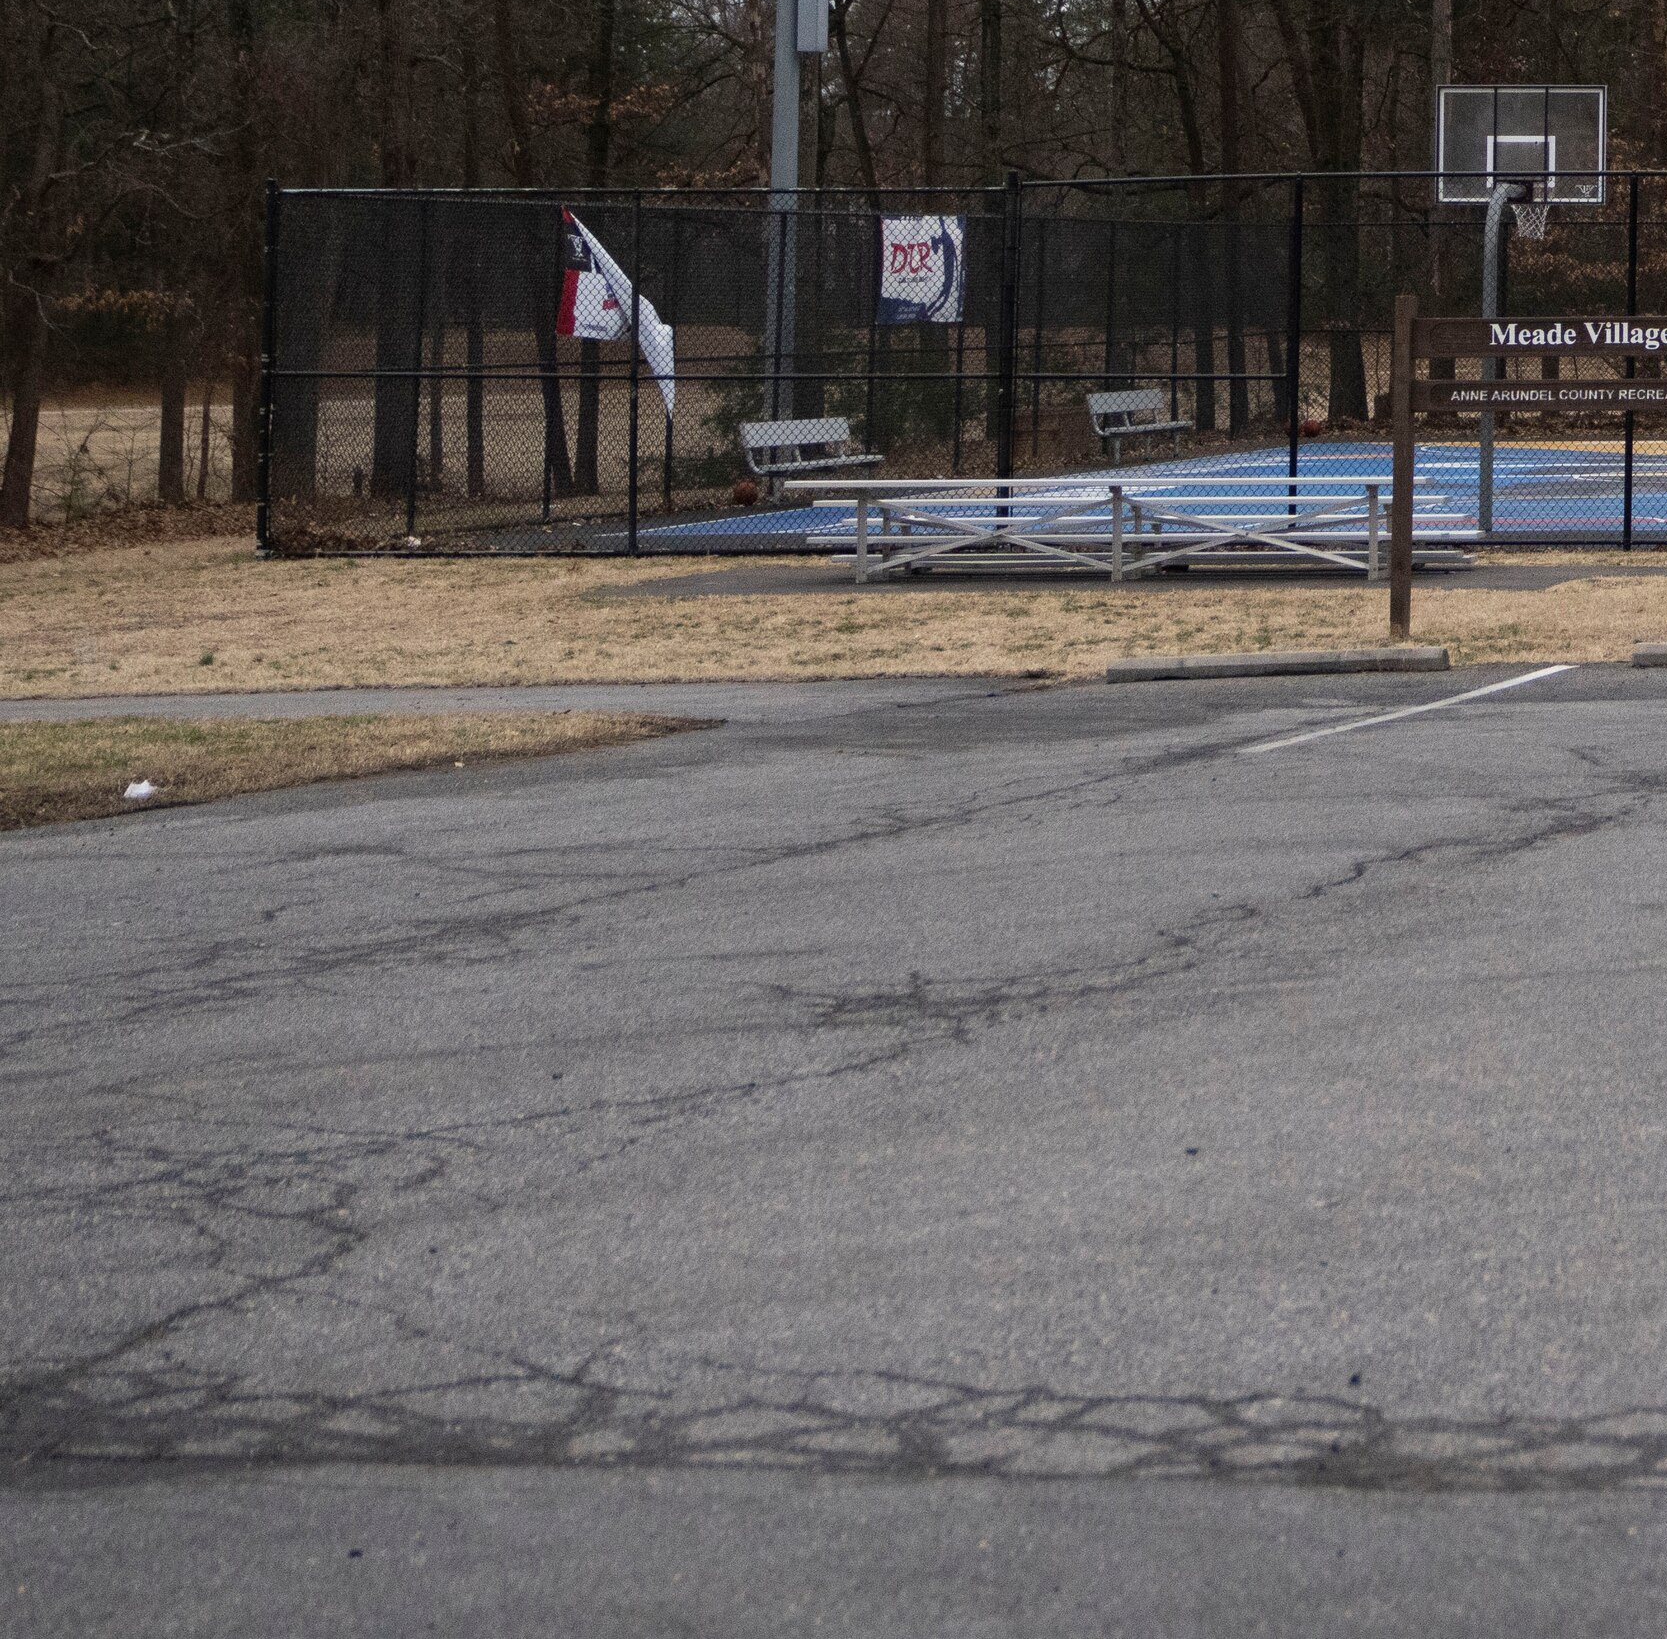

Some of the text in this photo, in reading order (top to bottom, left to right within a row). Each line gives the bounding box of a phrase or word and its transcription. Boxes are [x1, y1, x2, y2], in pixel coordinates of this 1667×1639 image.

[1489, 323, 1577, 346] Meade
[1450, 390, 1489, 401] ANNE
[1491, 390, 1556, 401] ARUNDEL
[1559, 389, 1614, 400] COUNTY
